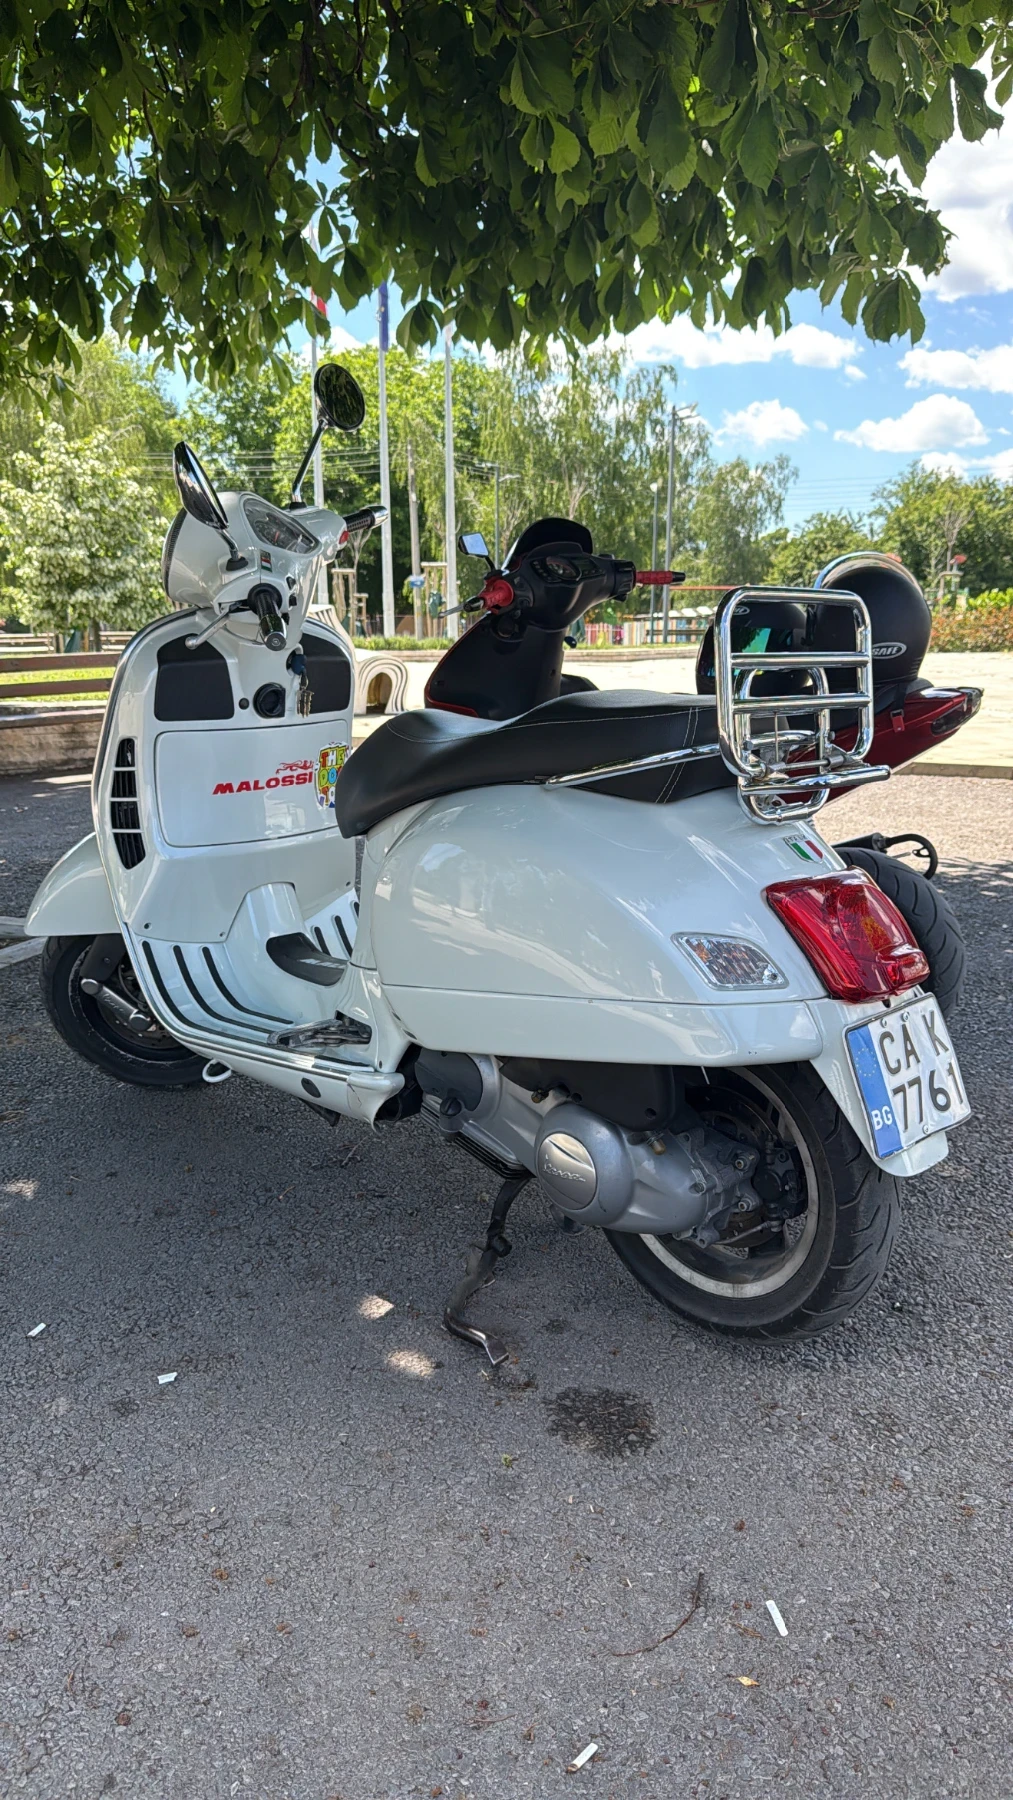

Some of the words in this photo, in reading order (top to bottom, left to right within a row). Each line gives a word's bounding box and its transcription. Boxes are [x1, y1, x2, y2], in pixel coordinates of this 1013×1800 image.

[321, 750, 345, 768] THE
[212, 772, 313, 795] MALOSSI
[319, 767, 342, 787] DO
[879, 1023, 920, 1075] CA
[922, 1010, 949, 1057] K
[892, 1062, 963, 1133] 7761
[871, 1105, 892, 1130] BG
